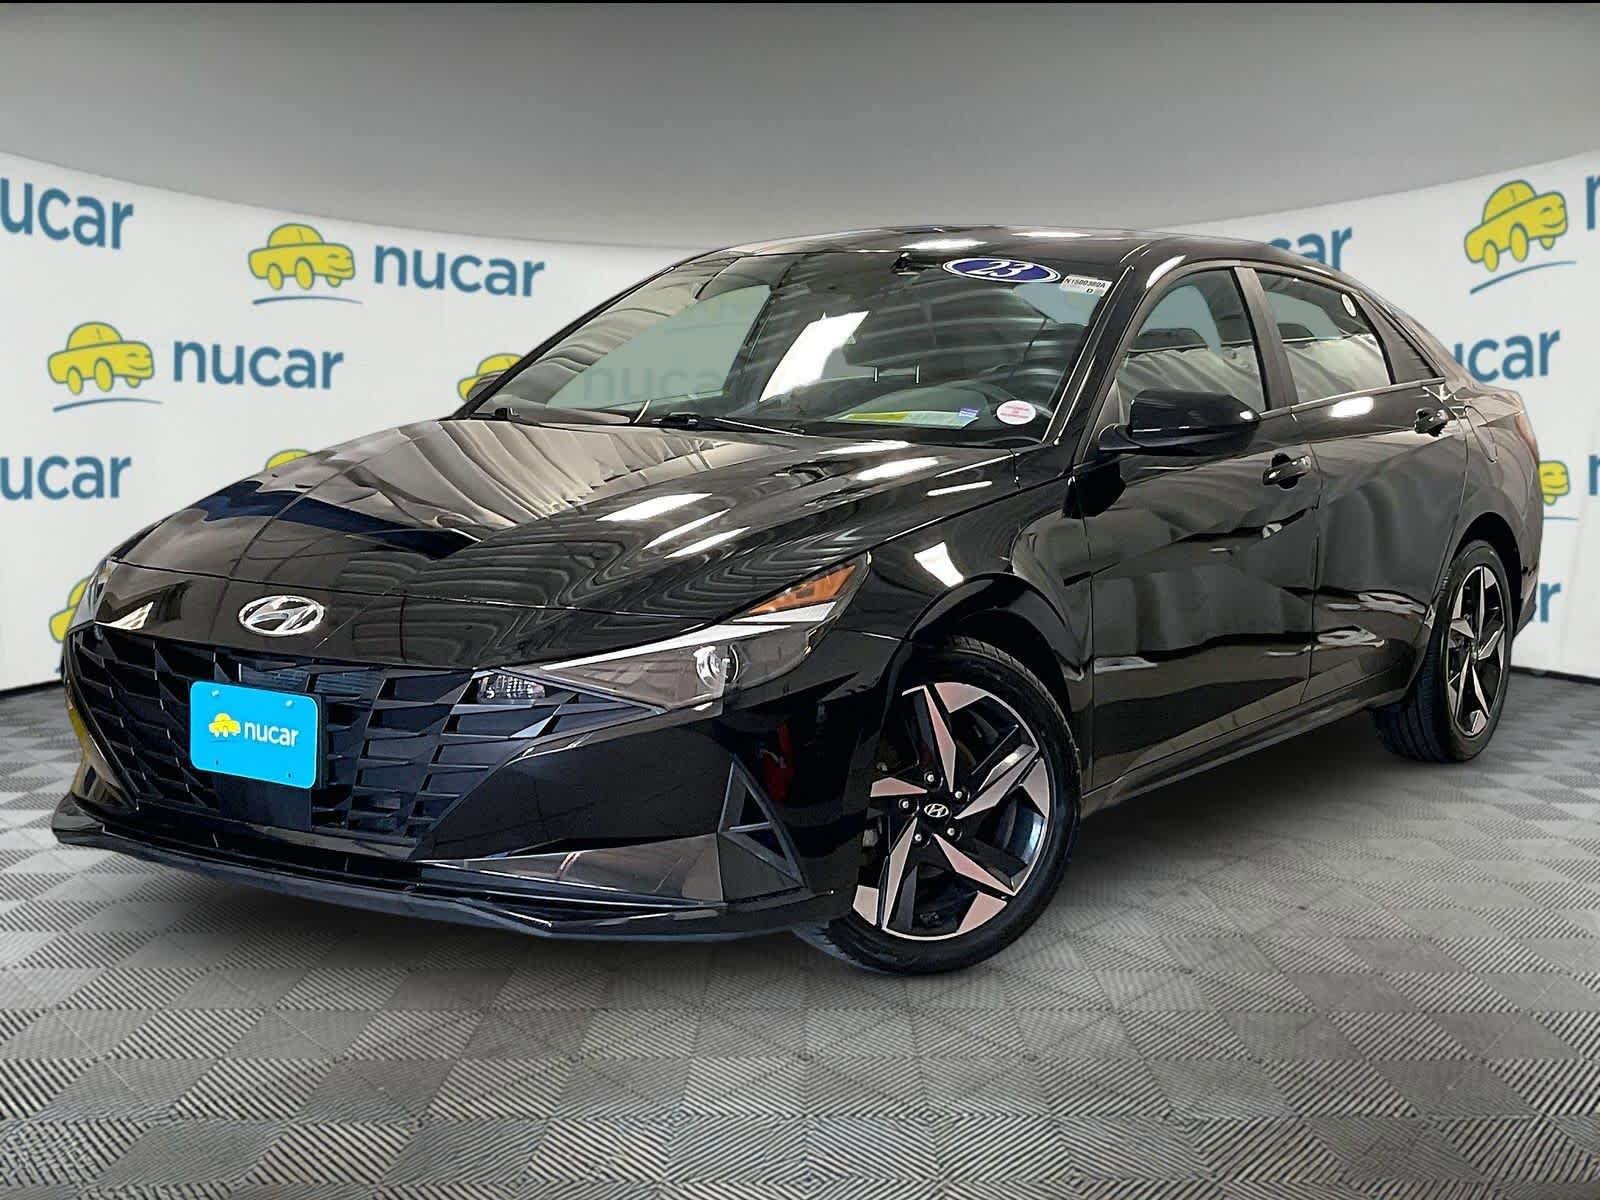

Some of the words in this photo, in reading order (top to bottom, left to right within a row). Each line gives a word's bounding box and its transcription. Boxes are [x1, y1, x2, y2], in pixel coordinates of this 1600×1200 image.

[373, 245, 545, 297] nucar
[966, 261, 1033, 277] 23
[172, 340, 344, 389] nucar
[244, 721, 299, 747] nucar
